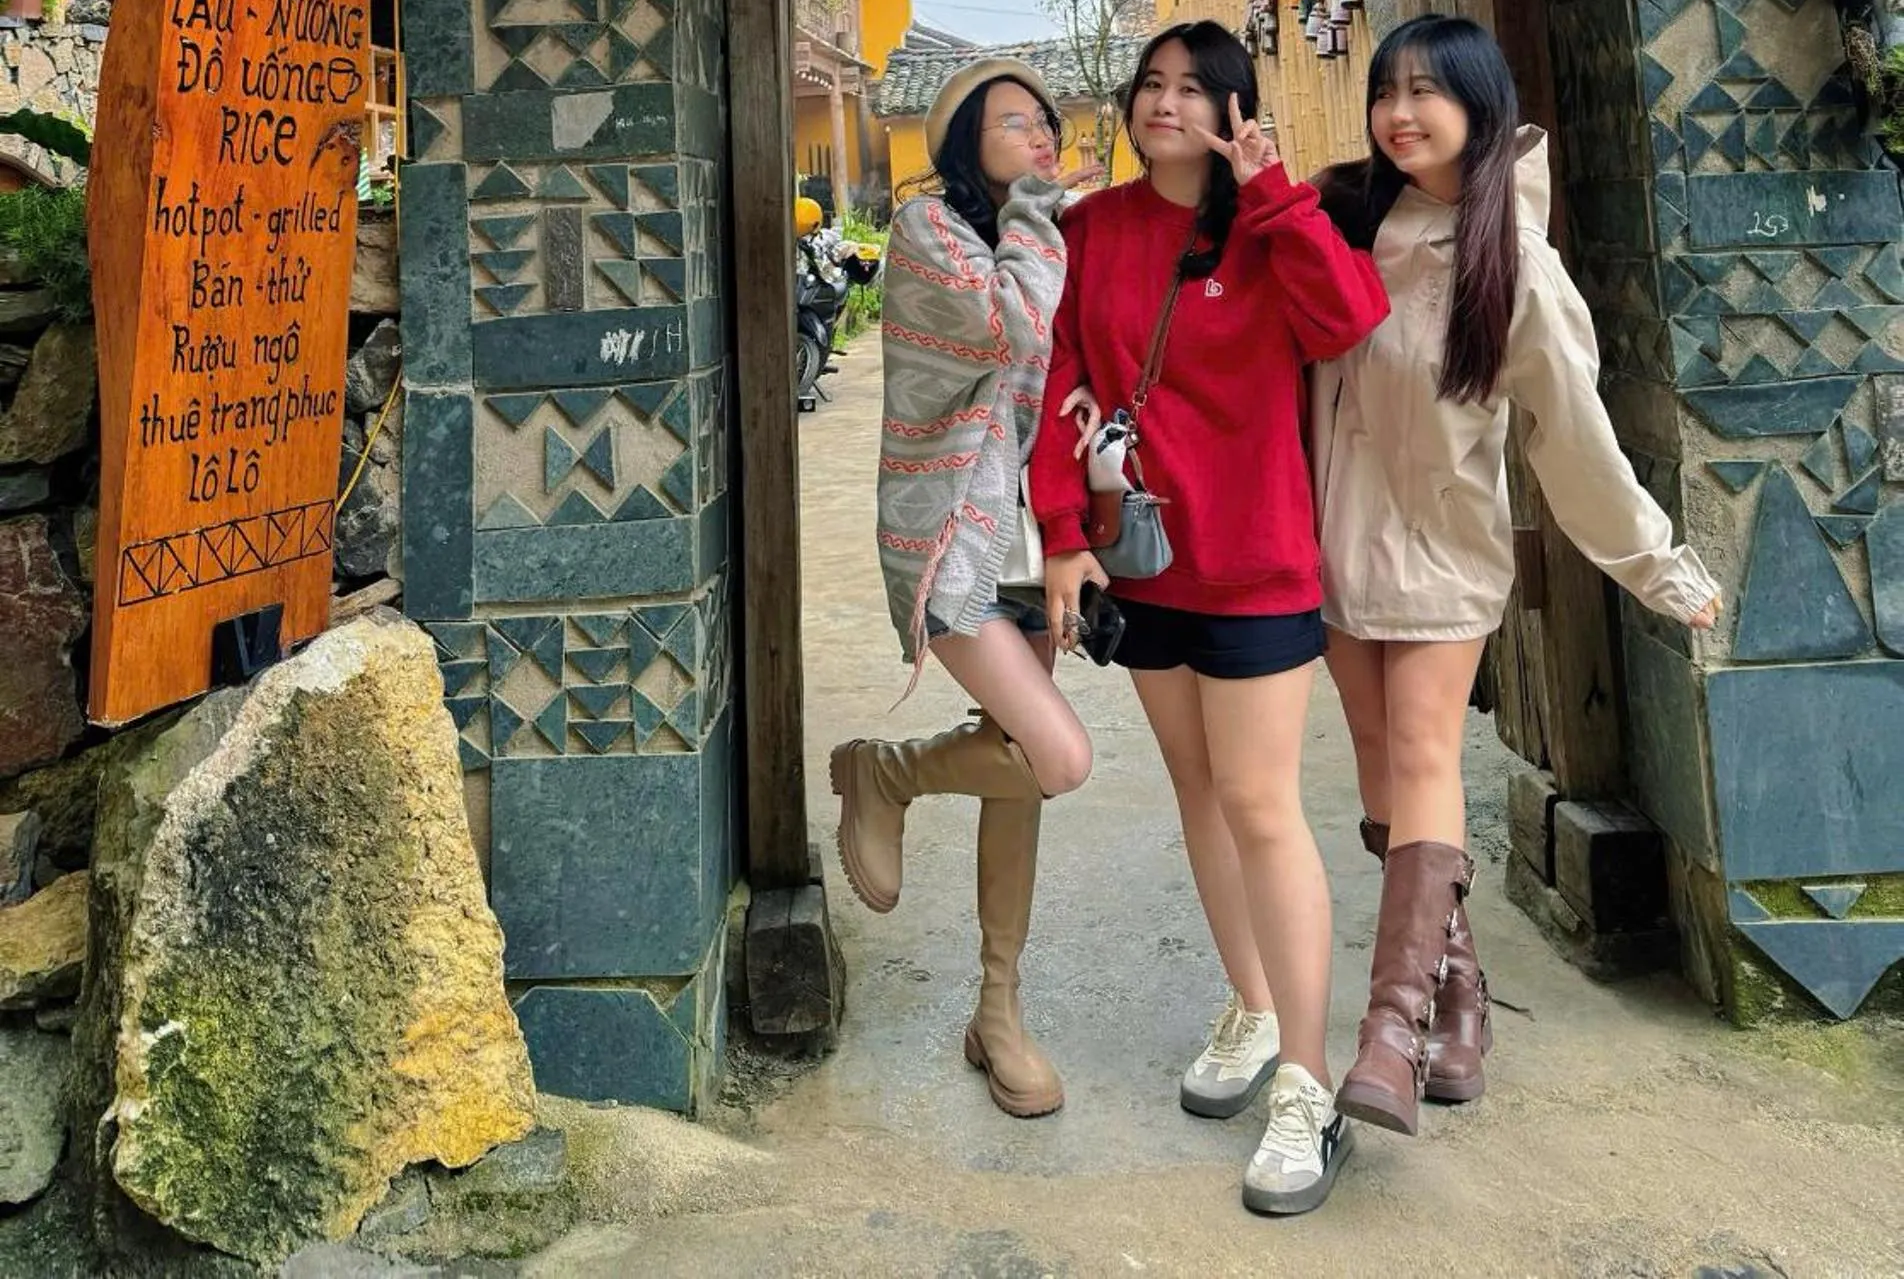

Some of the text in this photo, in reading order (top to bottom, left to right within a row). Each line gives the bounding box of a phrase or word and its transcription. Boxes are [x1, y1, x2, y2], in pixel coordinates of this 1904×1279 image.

[267, 190, 346, 253] grilled
[191, 260, 243, 309] Bán
[173, 320, 301, 384] Rượu ngô
[140, 393, 201, 447] thuê
[211, 392, 281, 446] trang
